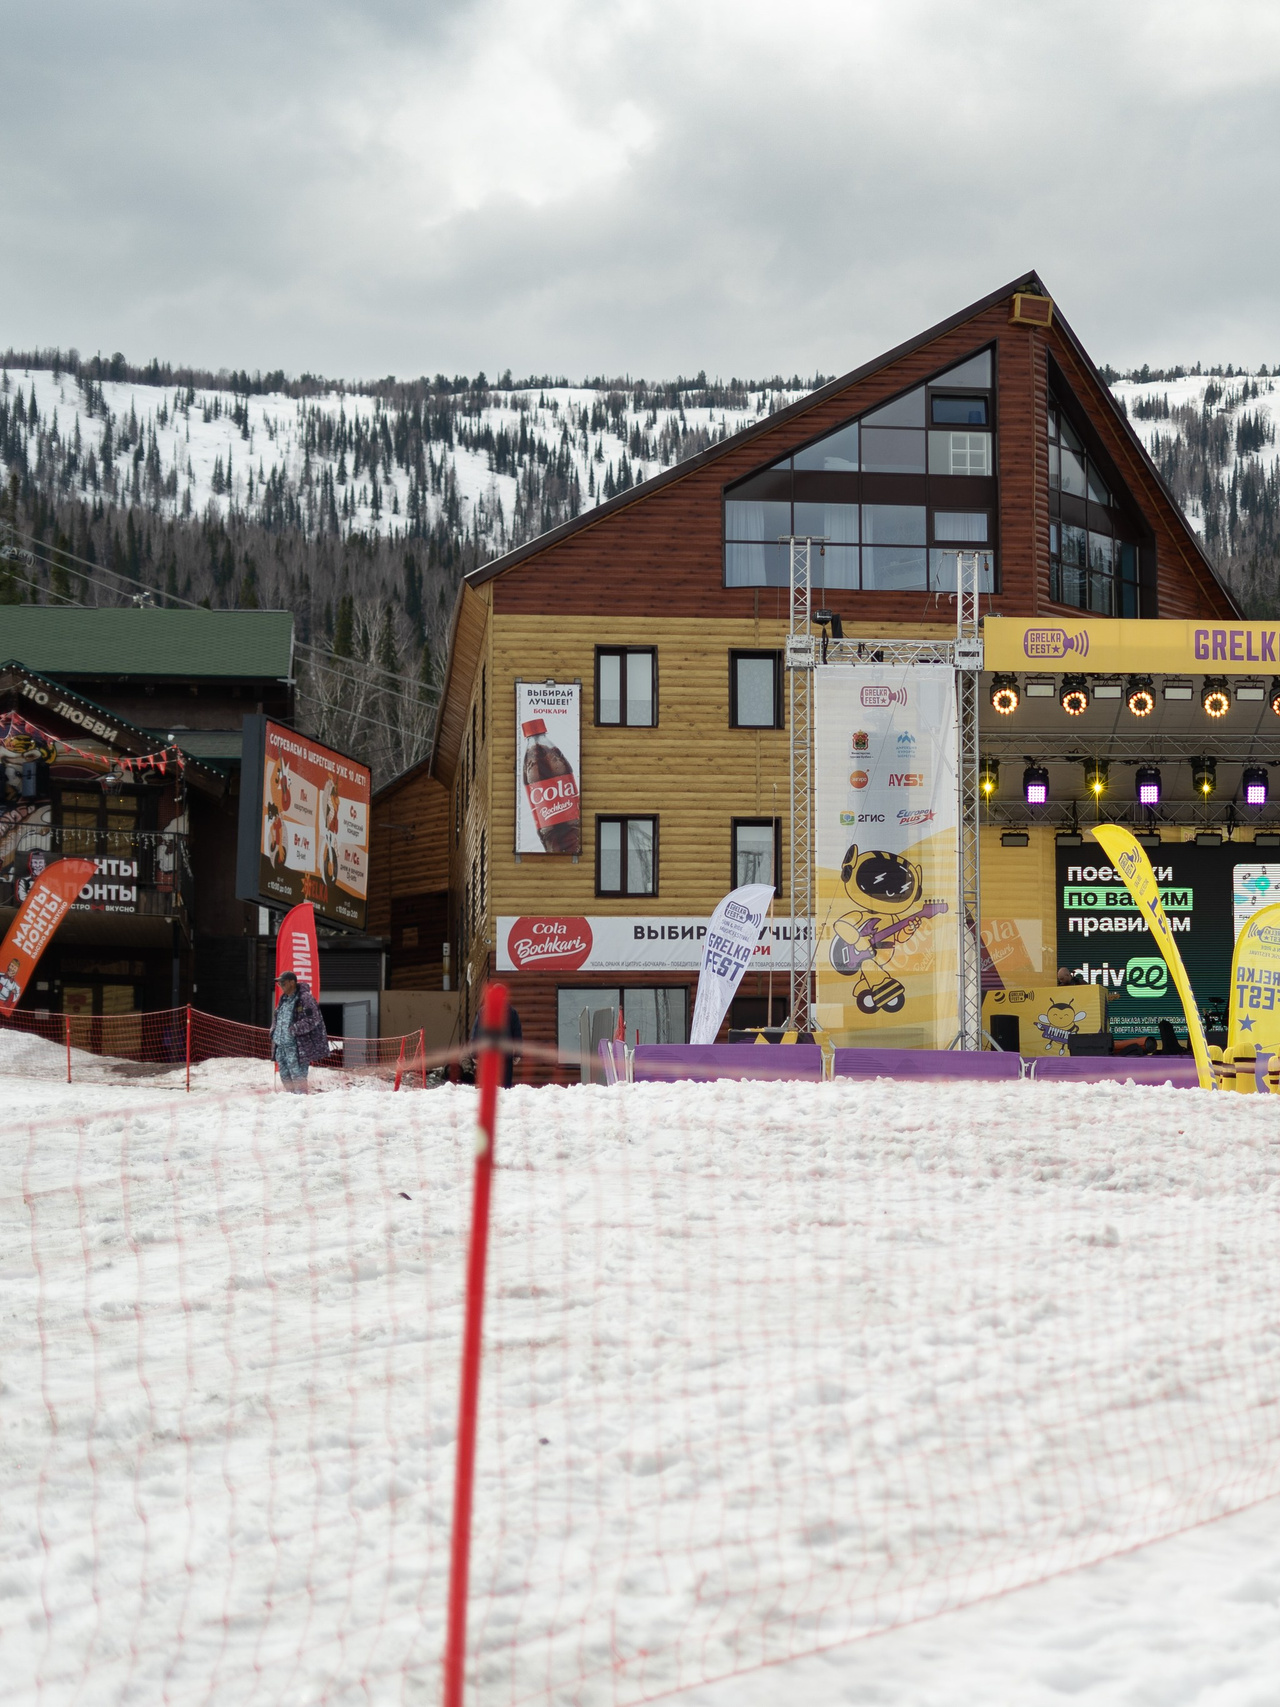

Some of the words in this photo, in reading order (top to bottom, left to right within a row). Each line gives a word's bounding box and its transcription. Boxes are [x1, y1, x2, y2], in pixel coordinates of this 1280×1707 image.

[1030, 633, 1061, 642] GRELKA
[1030, 644, 1051, 654] FEST
[527, 689, 573, 697] ВЫБИРАЙ
[22, 684, 48, 705] ПО
[53, 702, 118, 742] ЛЮБВИ
[269, 733, 302, 758] СОГРЕВАЕМ
[303, 748, 307, 759] В
[336, 764, 348, 778] УЖЕ
[889, 774, 924, 787] AYS!
[530, 780, 576, 805] Cola
[540, 801, 573, 818] Bochkari
[858, 814, 886, 822] 2ГИС
[1069, 892, 1098, 906] по
[1105, 891, 1188, 906] ваим
[12, 885, 51, 948] МАНТЫ
[727, 910, 740, 918] FEST
[730, 904, 747, 915] GRELKA
[21, 893, 62, 955] ПОНТЫ
[31, 936, 47, 960] БЫСТРО
[52, 901, 68, 925] ВКУСНО
[532, 922, 567, 934] Cola
[634, 925, 708, 940] ВЫБИР
[980, 920, 1015, 949] ola
[514, 936, 587, 959] Bochkari
[708, 933, 751, 962] GRELKA
[705, 950, 744, 982] FEST
